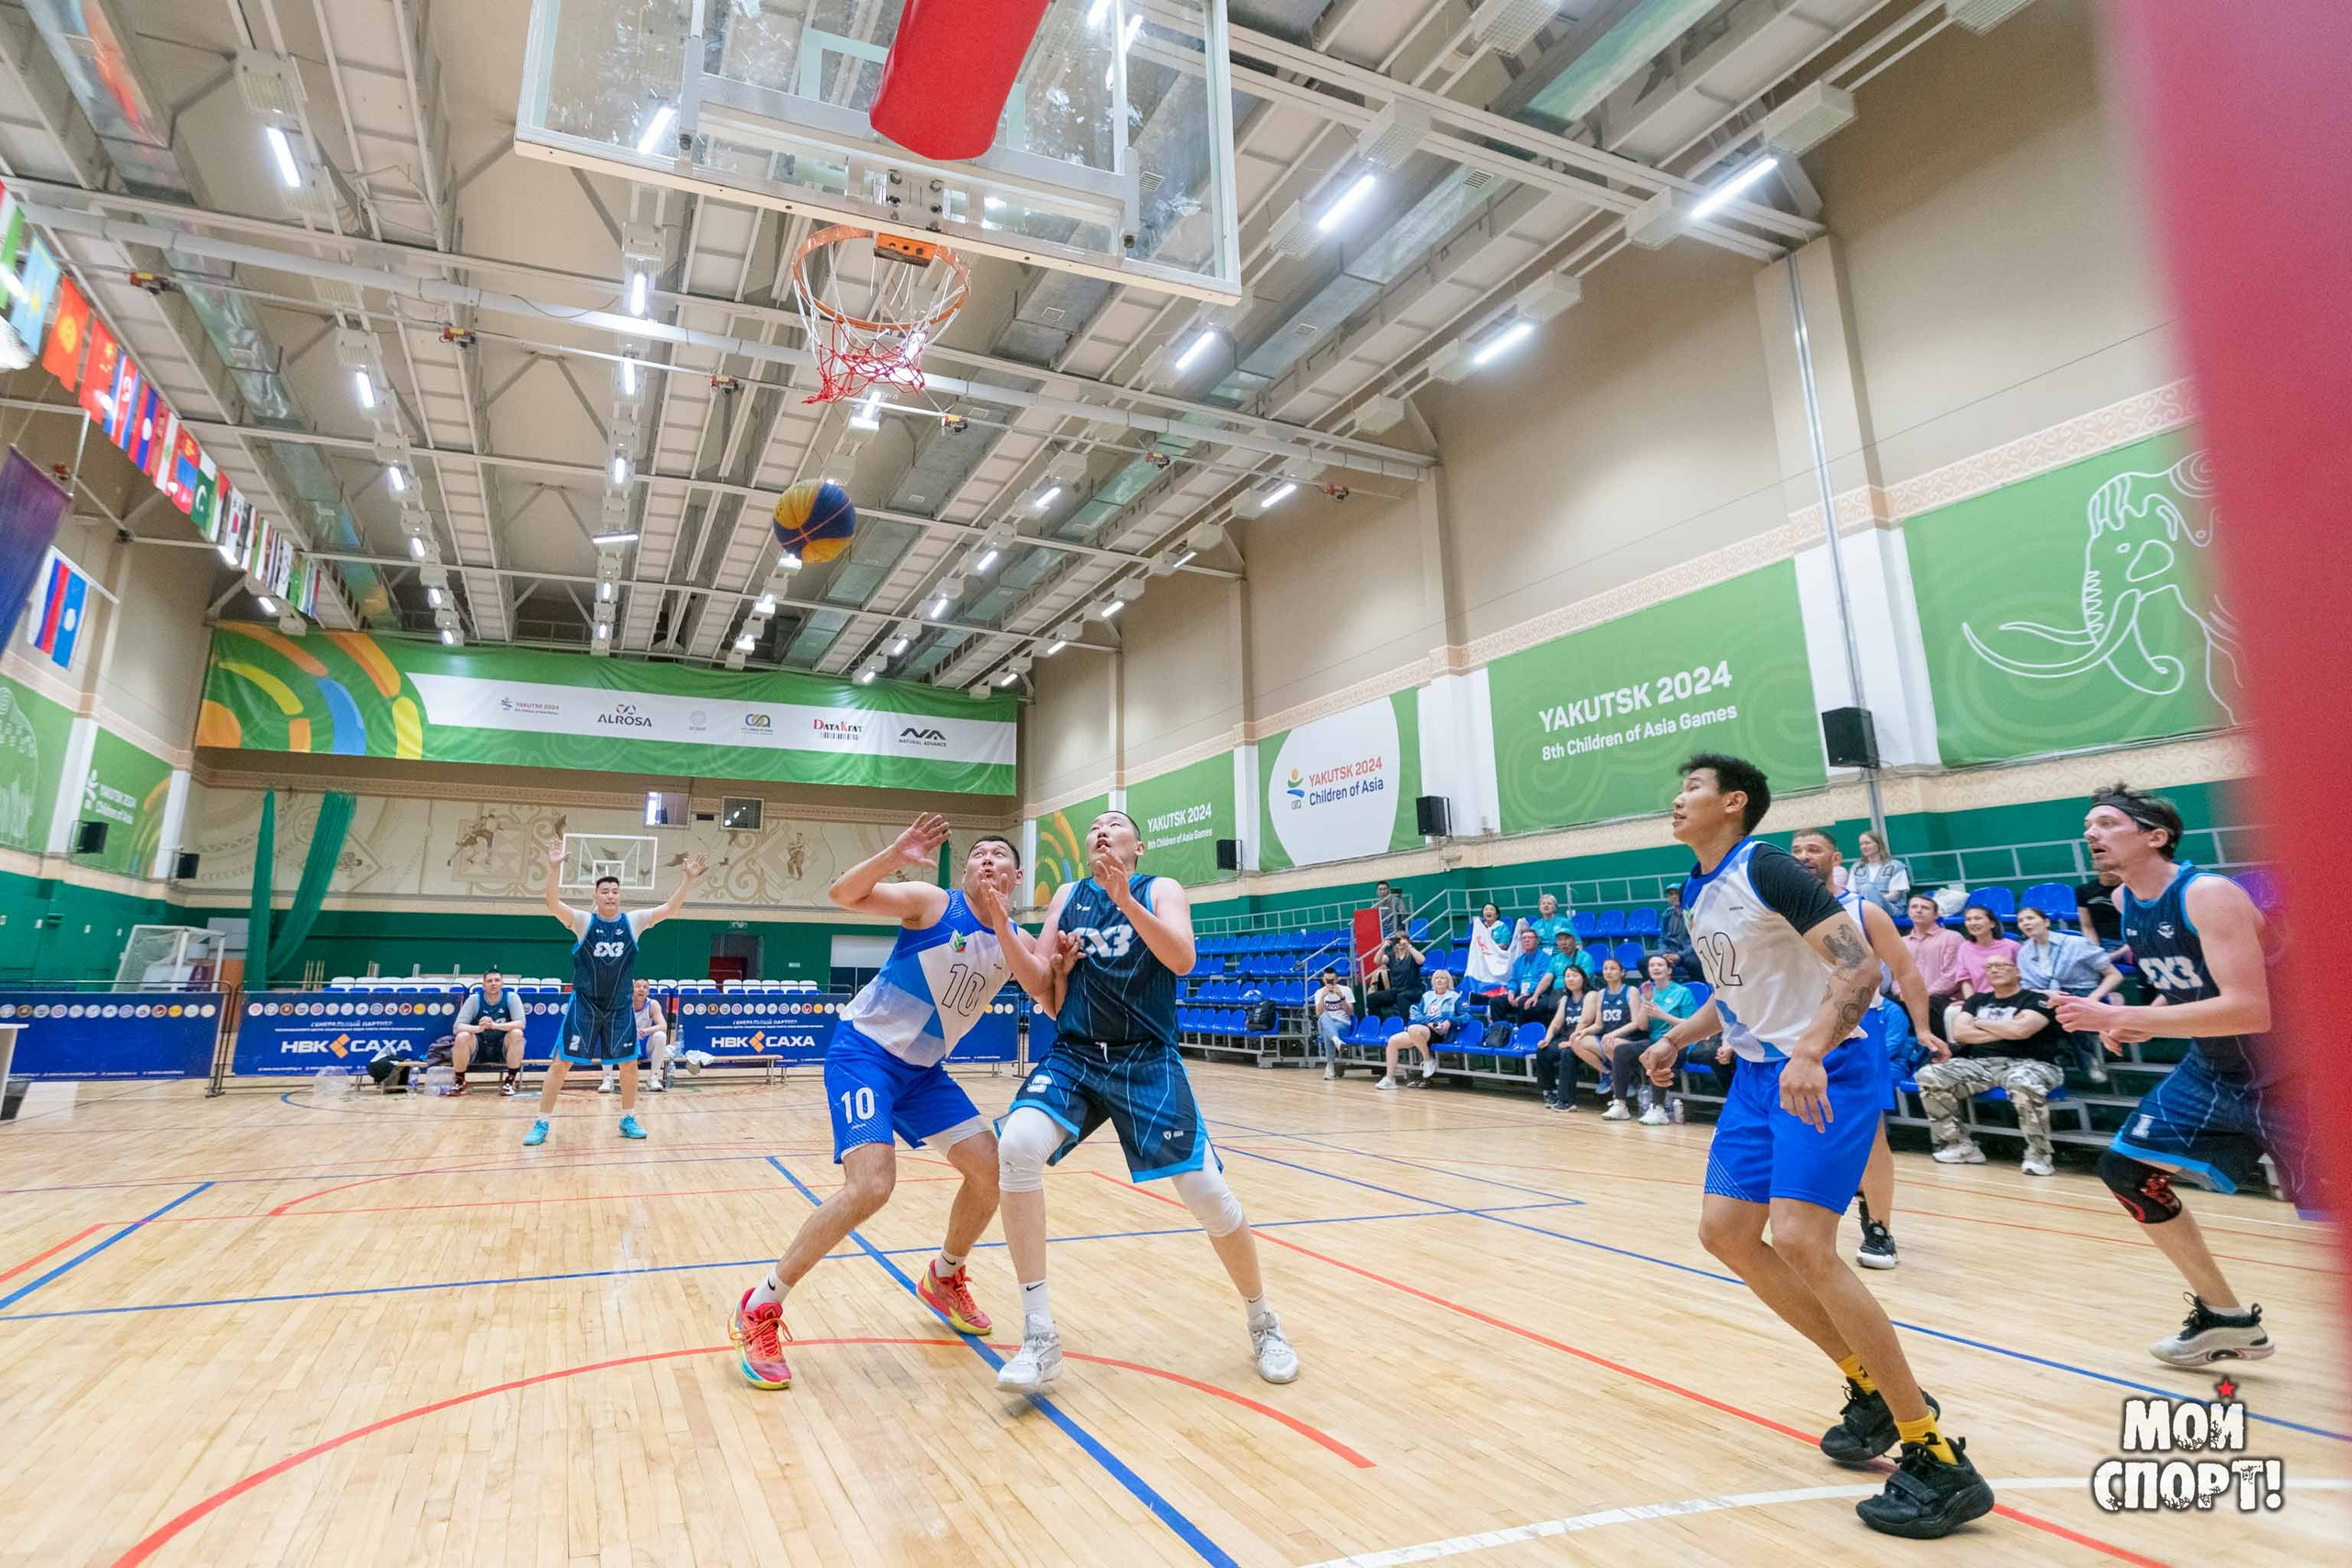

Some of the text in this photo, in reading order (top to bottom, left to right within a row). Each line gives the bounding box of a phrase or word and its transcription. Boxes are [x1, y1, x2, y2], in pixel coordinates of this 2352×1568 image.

[1538, 660, 1733, 733] YAKUTSK 2024
[597, 714, 652, 728] ALROSA
[1542, 705, 1738, 761] 8th Children of Asia Games
[1308, 756, 1383, 787] YAKUTSK 2024
[1309, 776, 1385, 807] Children of Asia
[1147, 802, 1213, 833] YAKUTSK 2024
[942, 963, 986, 1018] 10
[280, 1039, 413, 1054] НВК САХА
[569, 1034, 581, 1052] 2
[711, 1035, 816, 1048] НВК САХА
[840, 1087, 876, 1125] 10
